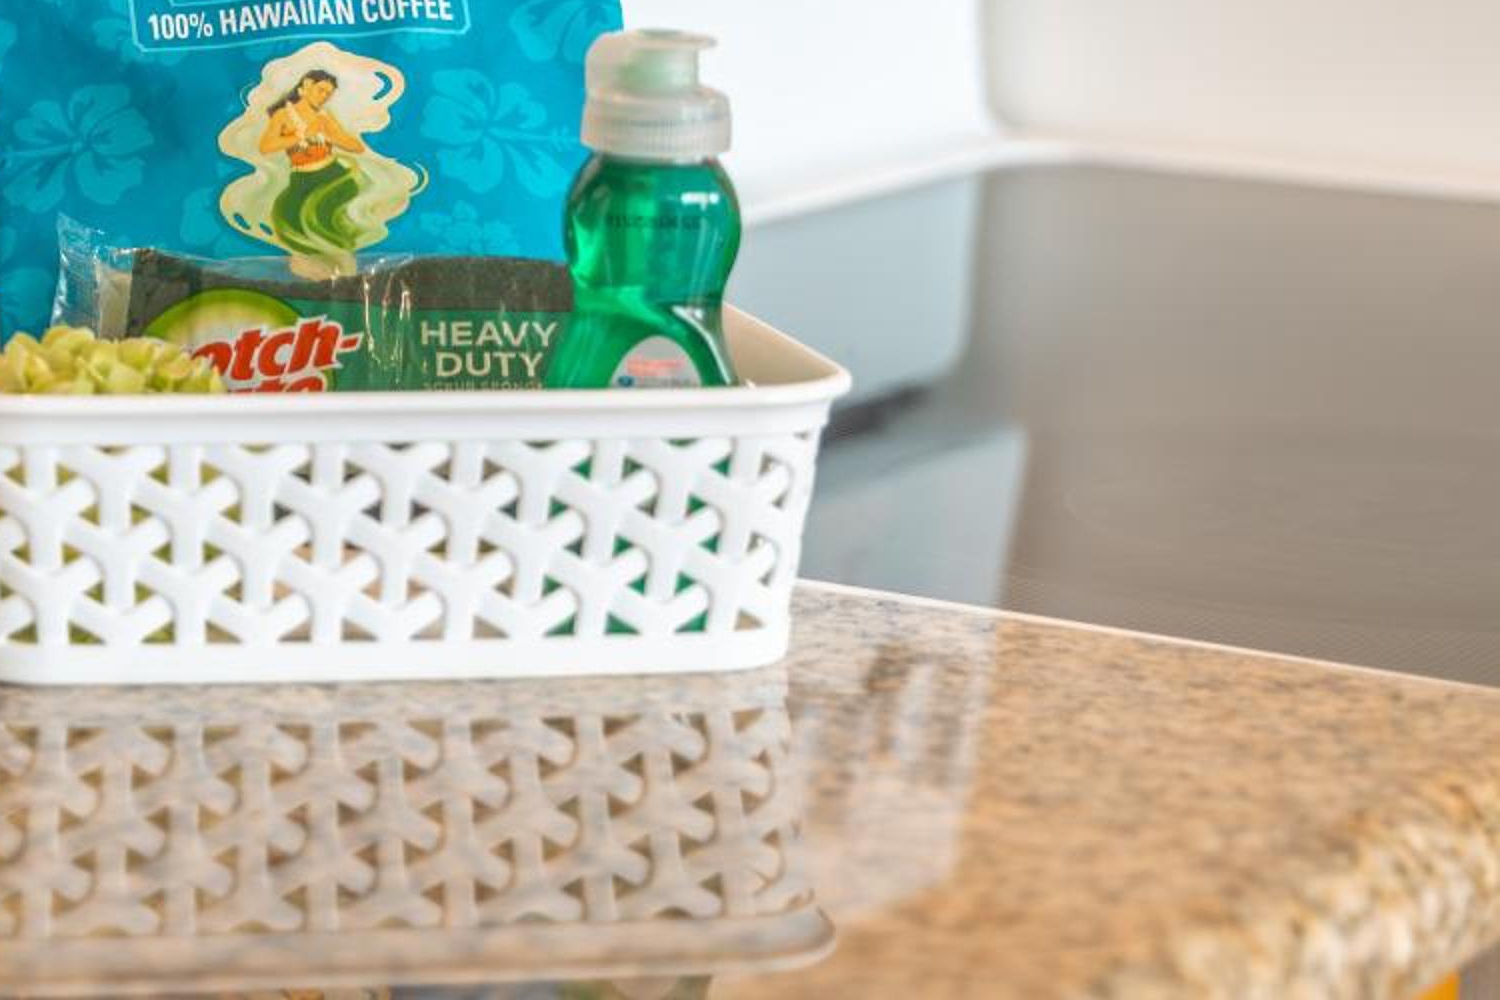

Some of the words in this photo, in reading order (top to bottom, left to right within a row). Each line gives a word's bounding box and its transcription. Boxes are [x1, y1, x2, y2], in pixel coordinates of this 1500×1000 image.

[148, 12, 213, 40] 100%
[421, 320, 558, 347] HEAVY
[189, 317, 362, 381] otch-
[436, 351, 543, 377] DUTY
